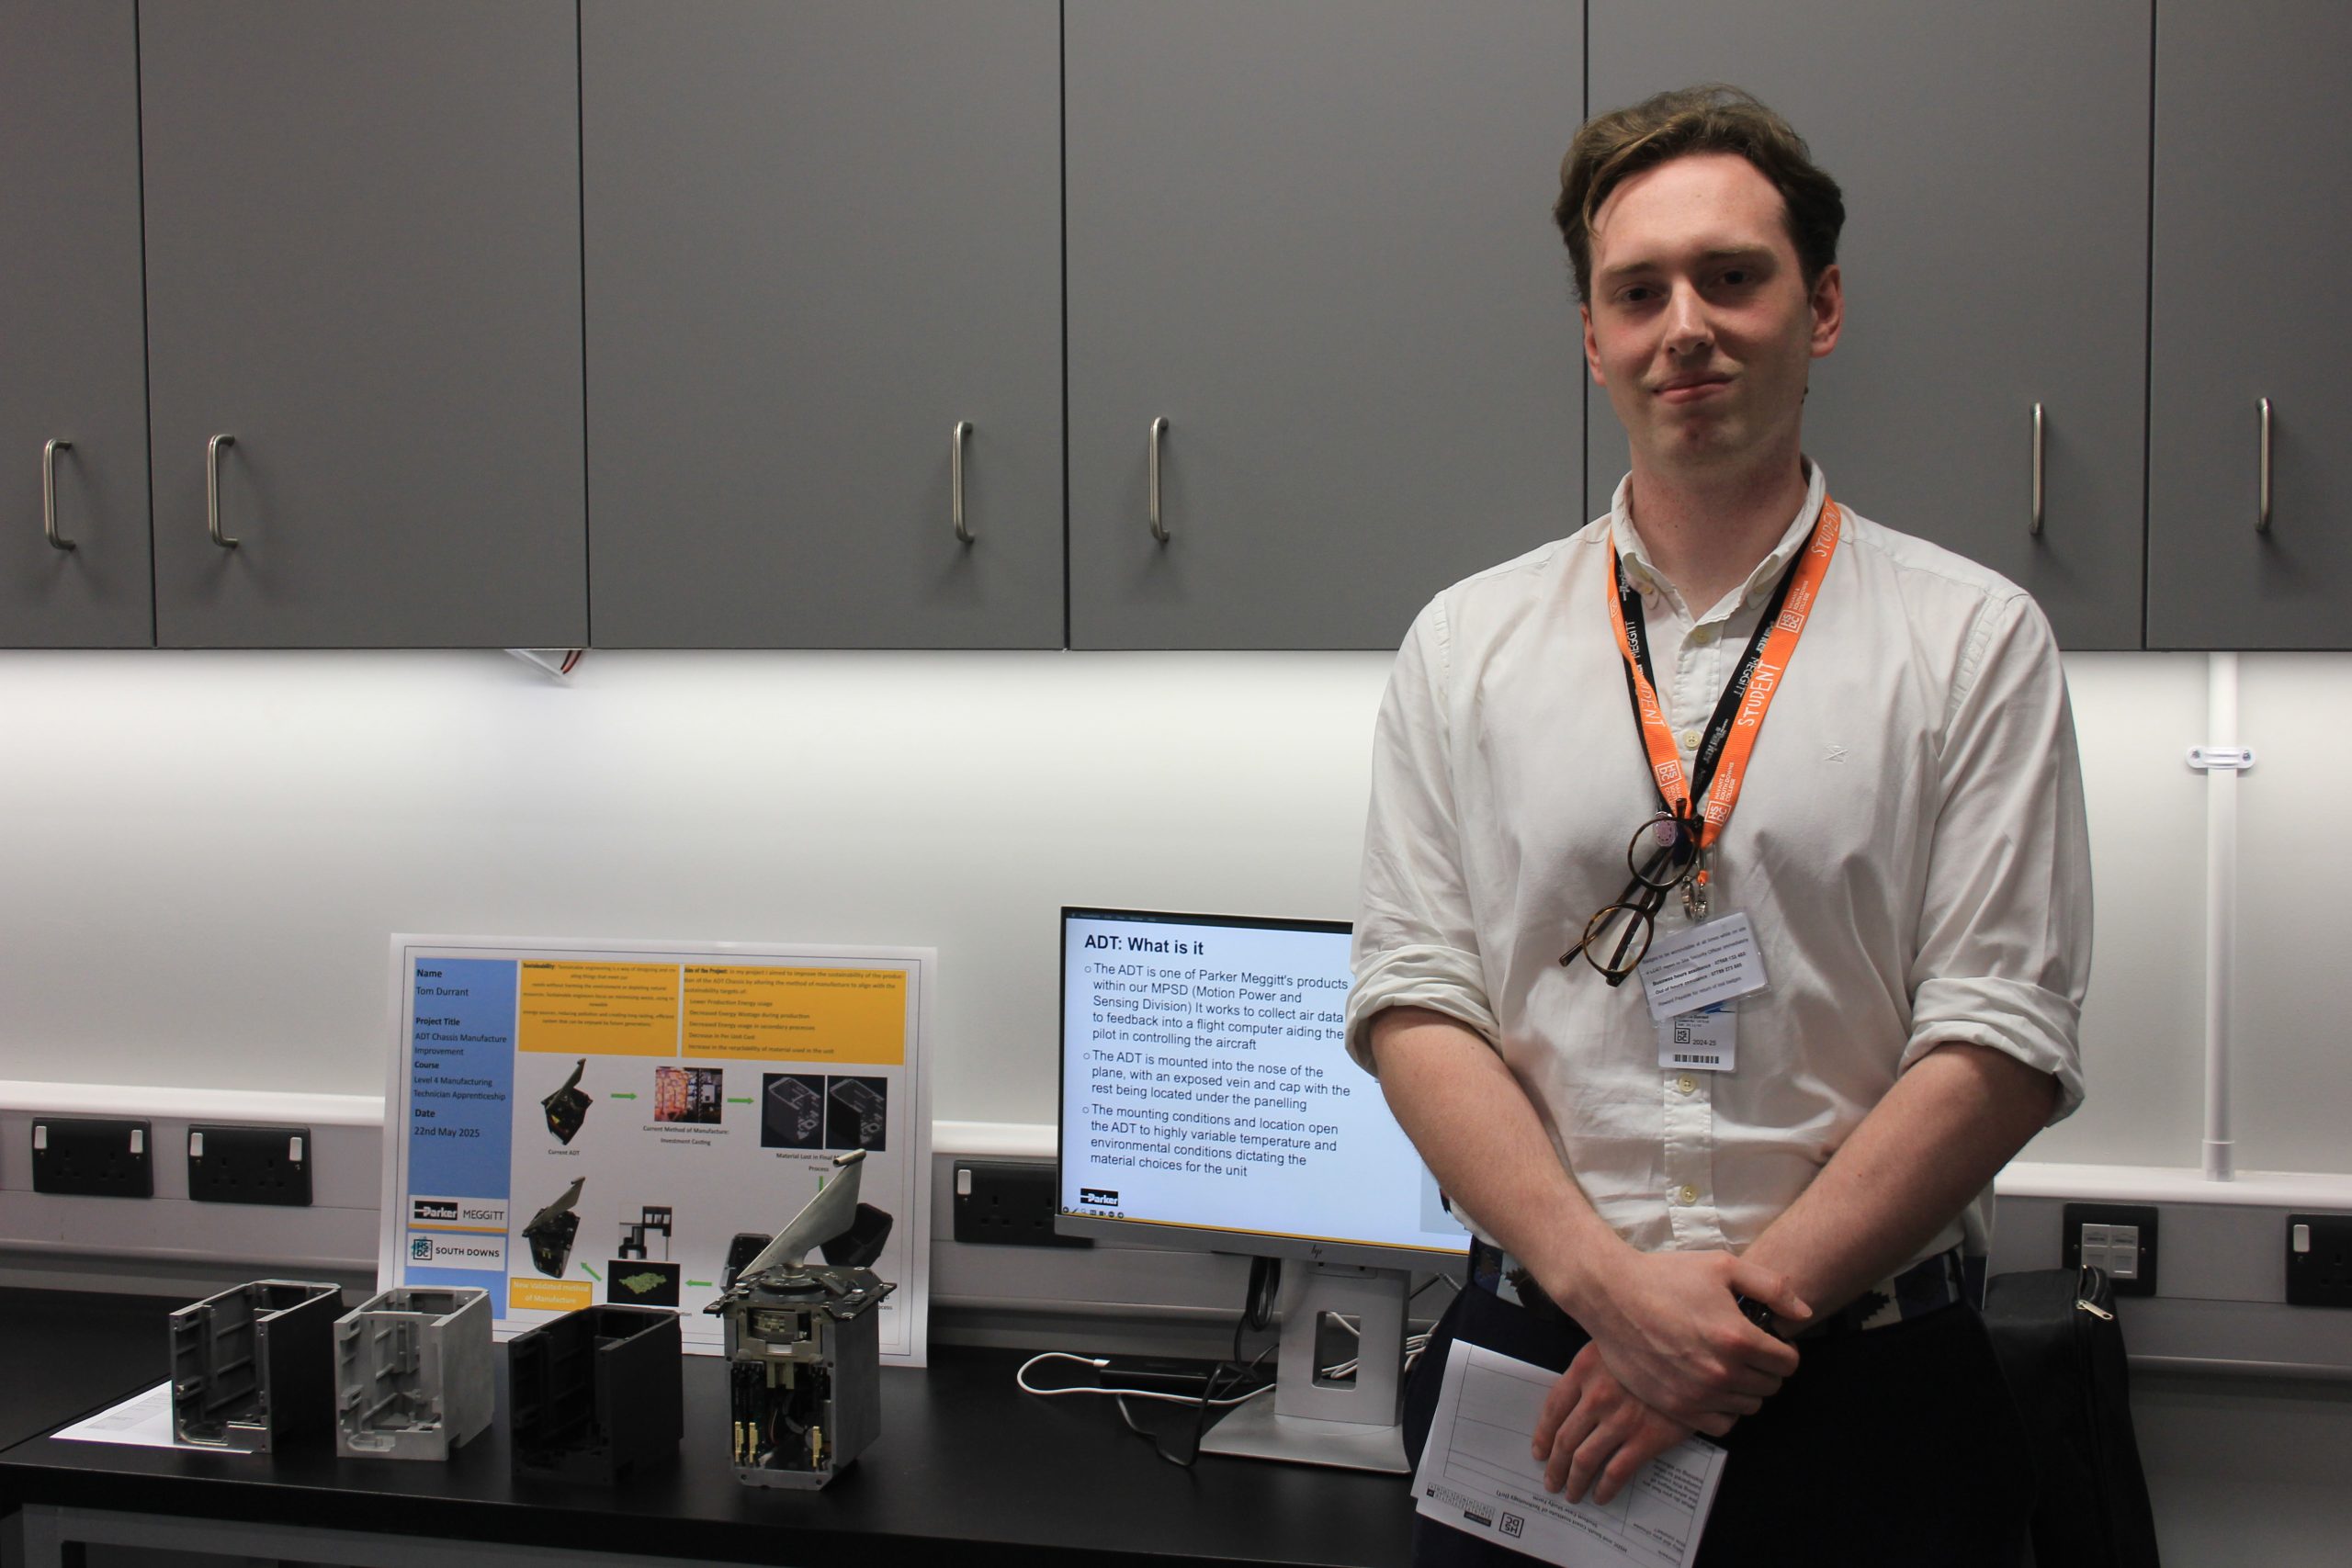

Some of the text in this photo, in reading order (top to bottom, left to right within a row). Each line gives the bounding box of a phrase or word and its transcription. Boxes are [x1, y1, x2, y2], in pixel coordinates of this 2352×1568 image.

[1811, 501, 1838, 557] STUDENT
[1781, 614, 1792, 627] HS
[1789, 615, 1800, 629] DC
[1737, 660, 1781, 728] STUDENT
[1640, 681, 1667, 728] UDENT
[1659, 767, 1669, 781] DC
[1667, 764, 1677, 778] HS
[1720, 782, 1728, 801] SOUTH
[1724, 778, 1736, 802] COLLEGE
[1708, 806, 1719, 819] HS
[1716, 807, 1726, 821] DC
[1083, 933, 1204, 956] ADT: What is it
[416, 969, 443, 977] Name
[1093, 962, 1349, 990] The ADT is one of Parker Meggitt's products
[416, 987, 469, 997] Tom Durrant
[1092, 978, 1302, 1004] within our MPSD (Motion Power and
[1092, 994, 1344, 1023] Sensing Division) It works to collect air data
[415, 1017, 460, 1026] Project Title
[1092, 1011, 1345, 1042] to feedback into a flight computer aiding the
[414, 1032, 507, 1043] ADT Chassis Manufacture
[1092, 1028, 1257, 1051] pilot in controlling the aircraft
[414, 1047, 464, 1056] Improvement
[414, 1061, 440, 1069] Course
[1091, 1049, 1324, 1078] The ADT is mounted into the nose of the
[440, 1077, 492, 1088] Manufacturing
[1091, 1066, 1351, 1097] plane, with an exposed vein and cap with the
[413, 1089, 506, 1101] Technician Apprenticeship
[1091, 1083, 1307, 1113] rest being located under the panelling
[414, 1109, 435, 1118] Date
[1091, 1102, 1339, 1136] The mounting conditions and location open
[414, 1126, 480, 1138] 22nd May 2025
[1091, 1120, 1338, 1152] the ADT to highly variable temperature and
[691, 1138, 711, 1146] Casting
[1091, 1137, 1307, 1167] environmental conditions dictating the
[1090, 1154, 1248, 1178] material choices for the unit
[1087, 1192, 1118, 1205] Parker
[423, 1206, 458, 1219] Parker
[416, 1242, 429, 1250] HS
[435, 1247, 500, 1258] SOUTH DOWNS
[416, 1249, 429, 1258] DC
